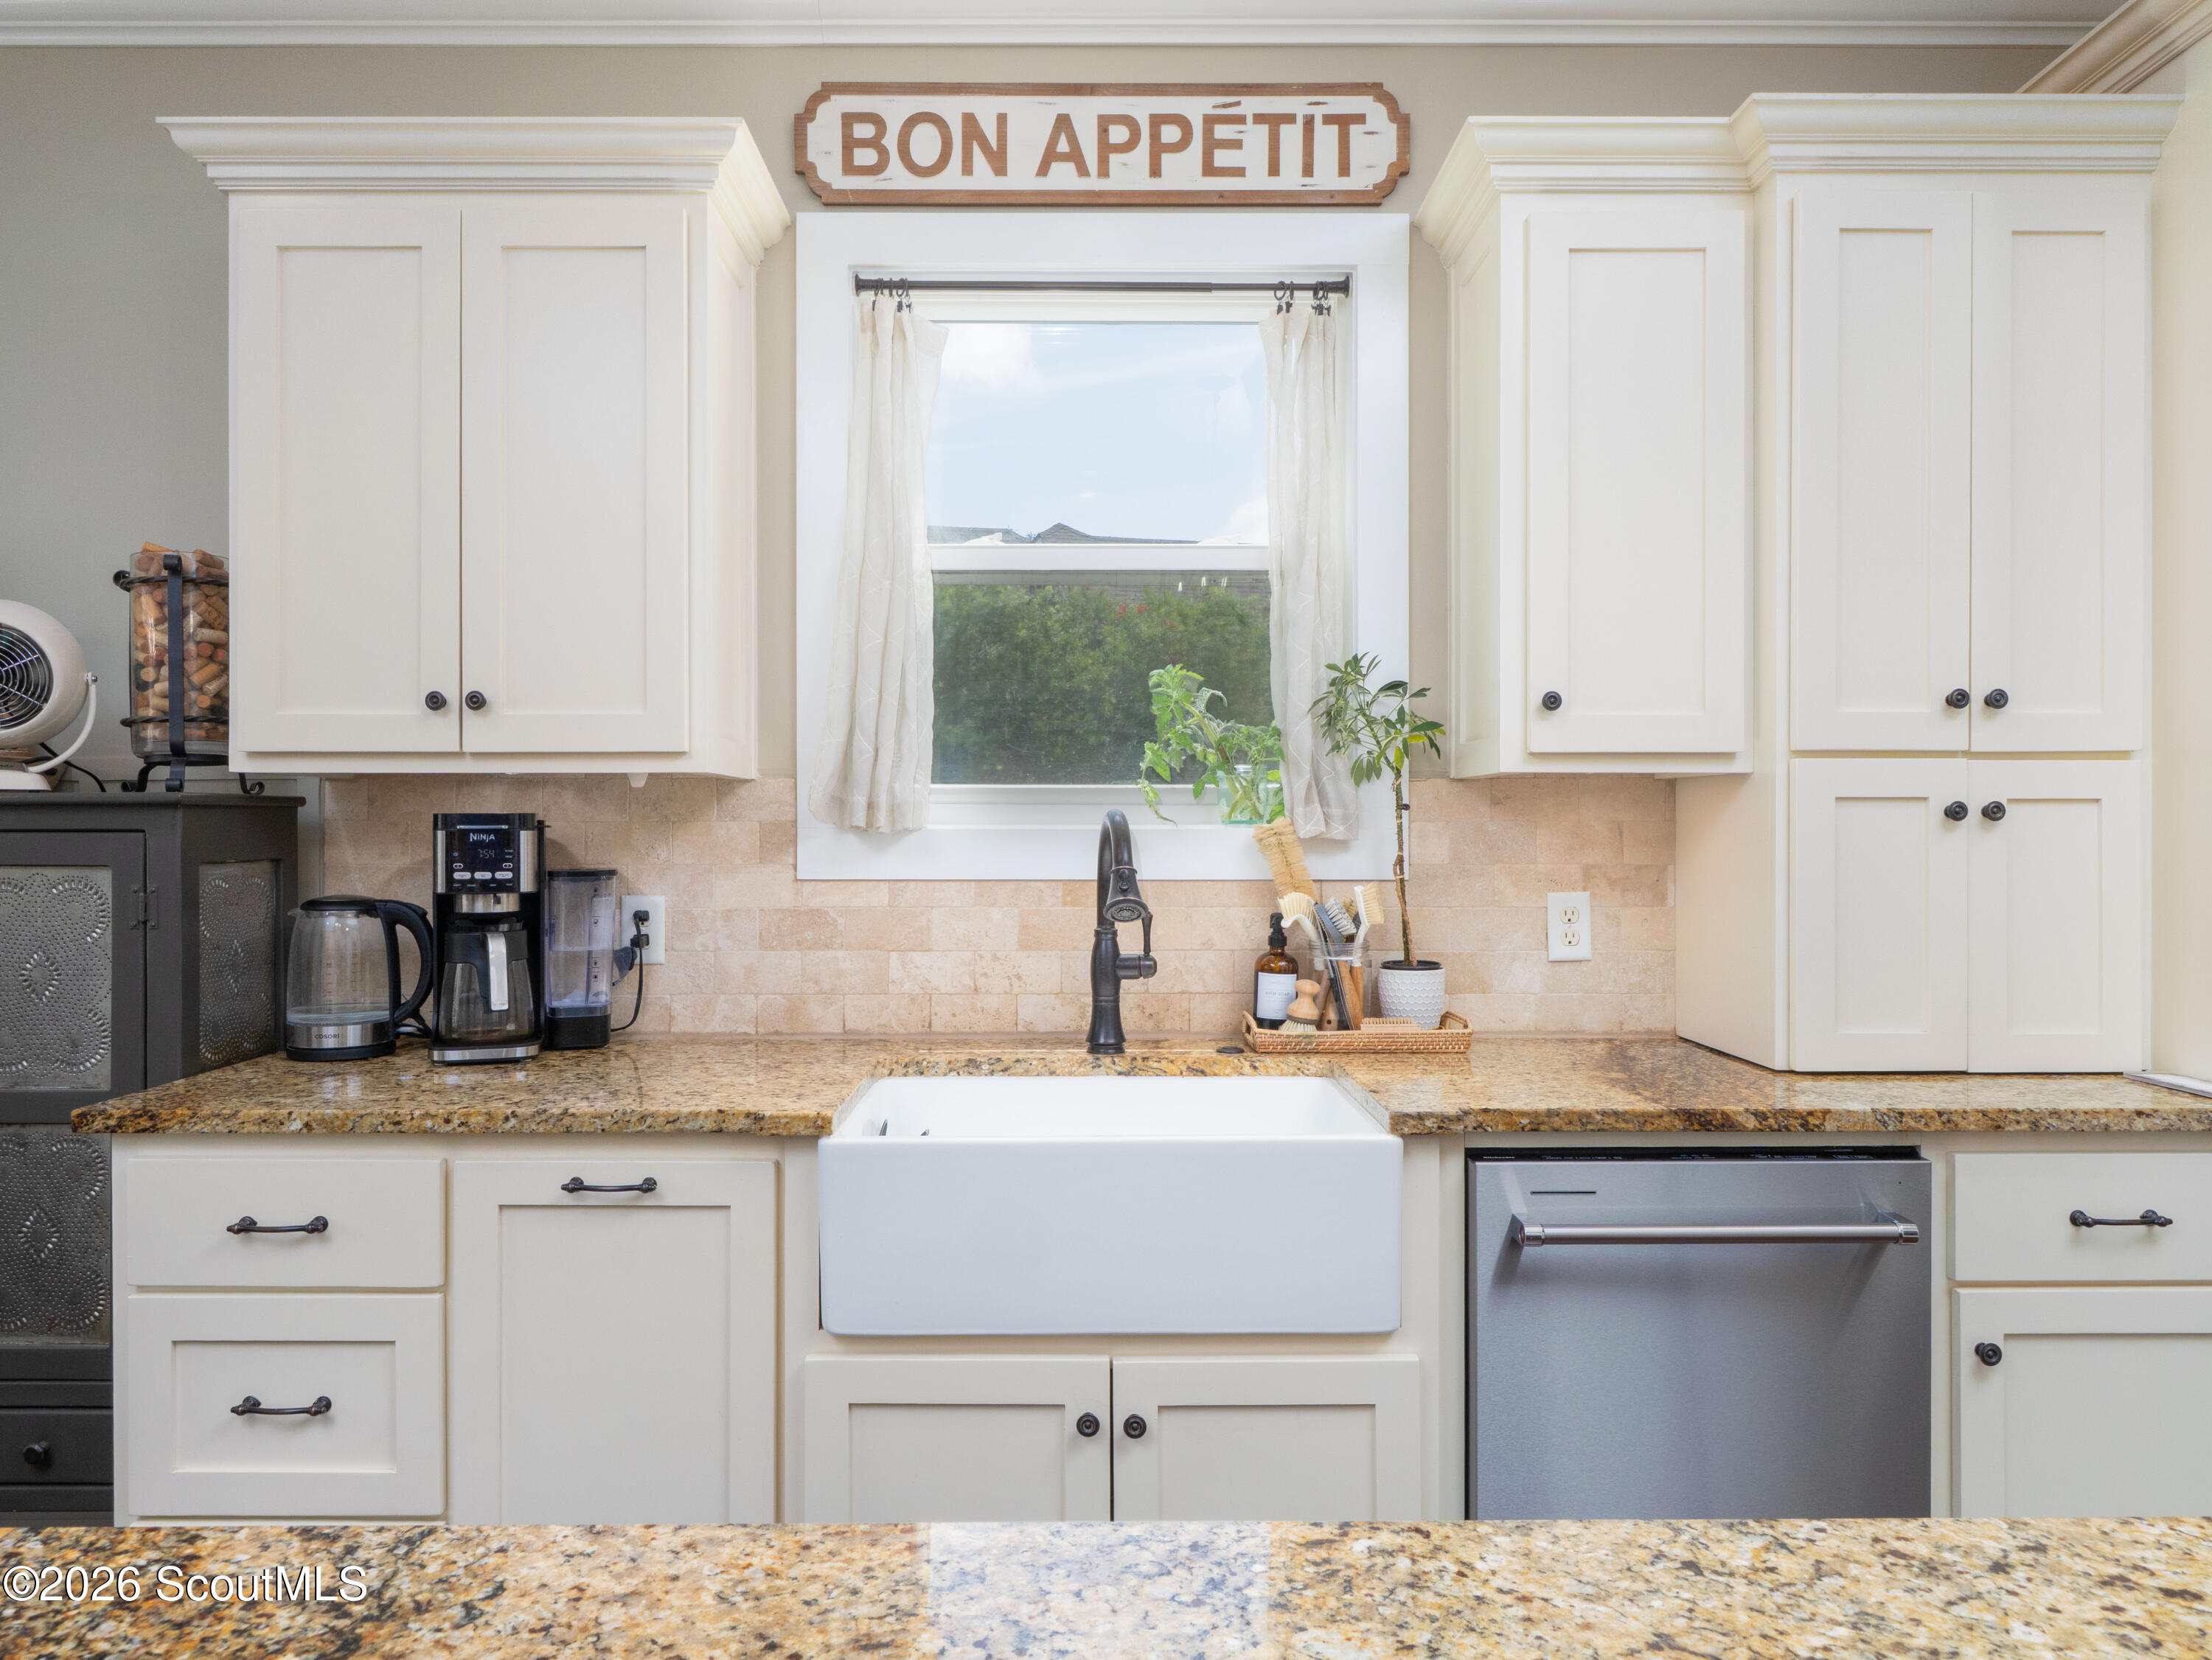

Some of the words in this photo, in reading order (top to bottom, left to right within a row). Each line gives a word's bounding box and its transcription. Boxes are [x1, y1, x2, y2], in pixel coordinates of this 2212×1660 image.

[841, 111, 1008, 178] BON
[1034, 100, 1367, 178] APPÉTIT
[478, 848, 495, 859] 7:54
